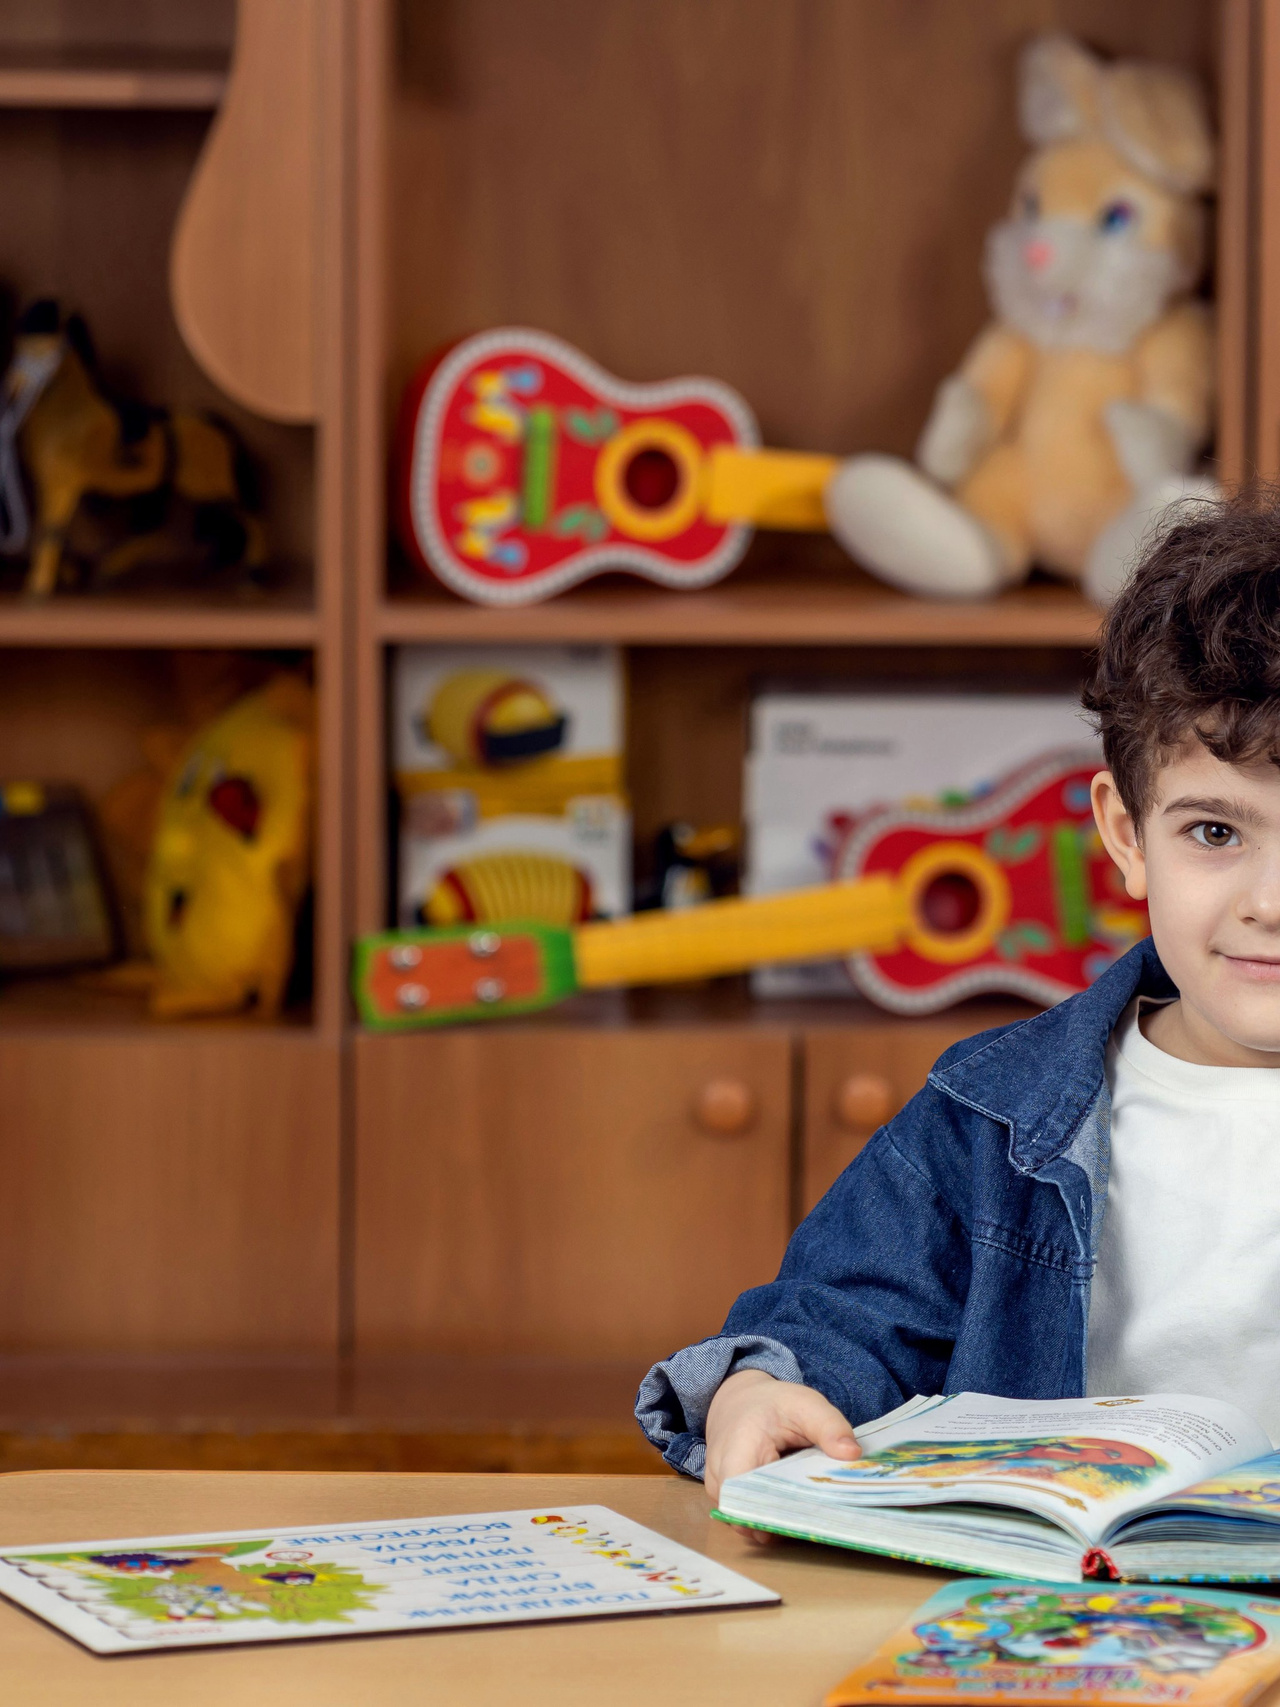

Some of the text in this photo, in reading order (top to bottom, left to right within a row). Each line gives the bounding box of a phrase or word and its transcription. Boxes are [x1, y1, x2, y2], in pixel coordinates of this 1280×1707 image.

[283, 1522, 512, 1546] ВОСКРЕСЕНЬЕ
[359, 1535, 511, 1553] СУББОТА
[374, 1546, 534, 1566] ПЯТНИЦА
[420, 1559, 545, 1576] ЧЕТВЕРГ
[446, 1571, 561, 1587] СРЕДА
[442, 1582, 596, 1602] ВТОРНИК
[400, 1591, 650, 1620] ПОНЕДЕЛЬНИК
